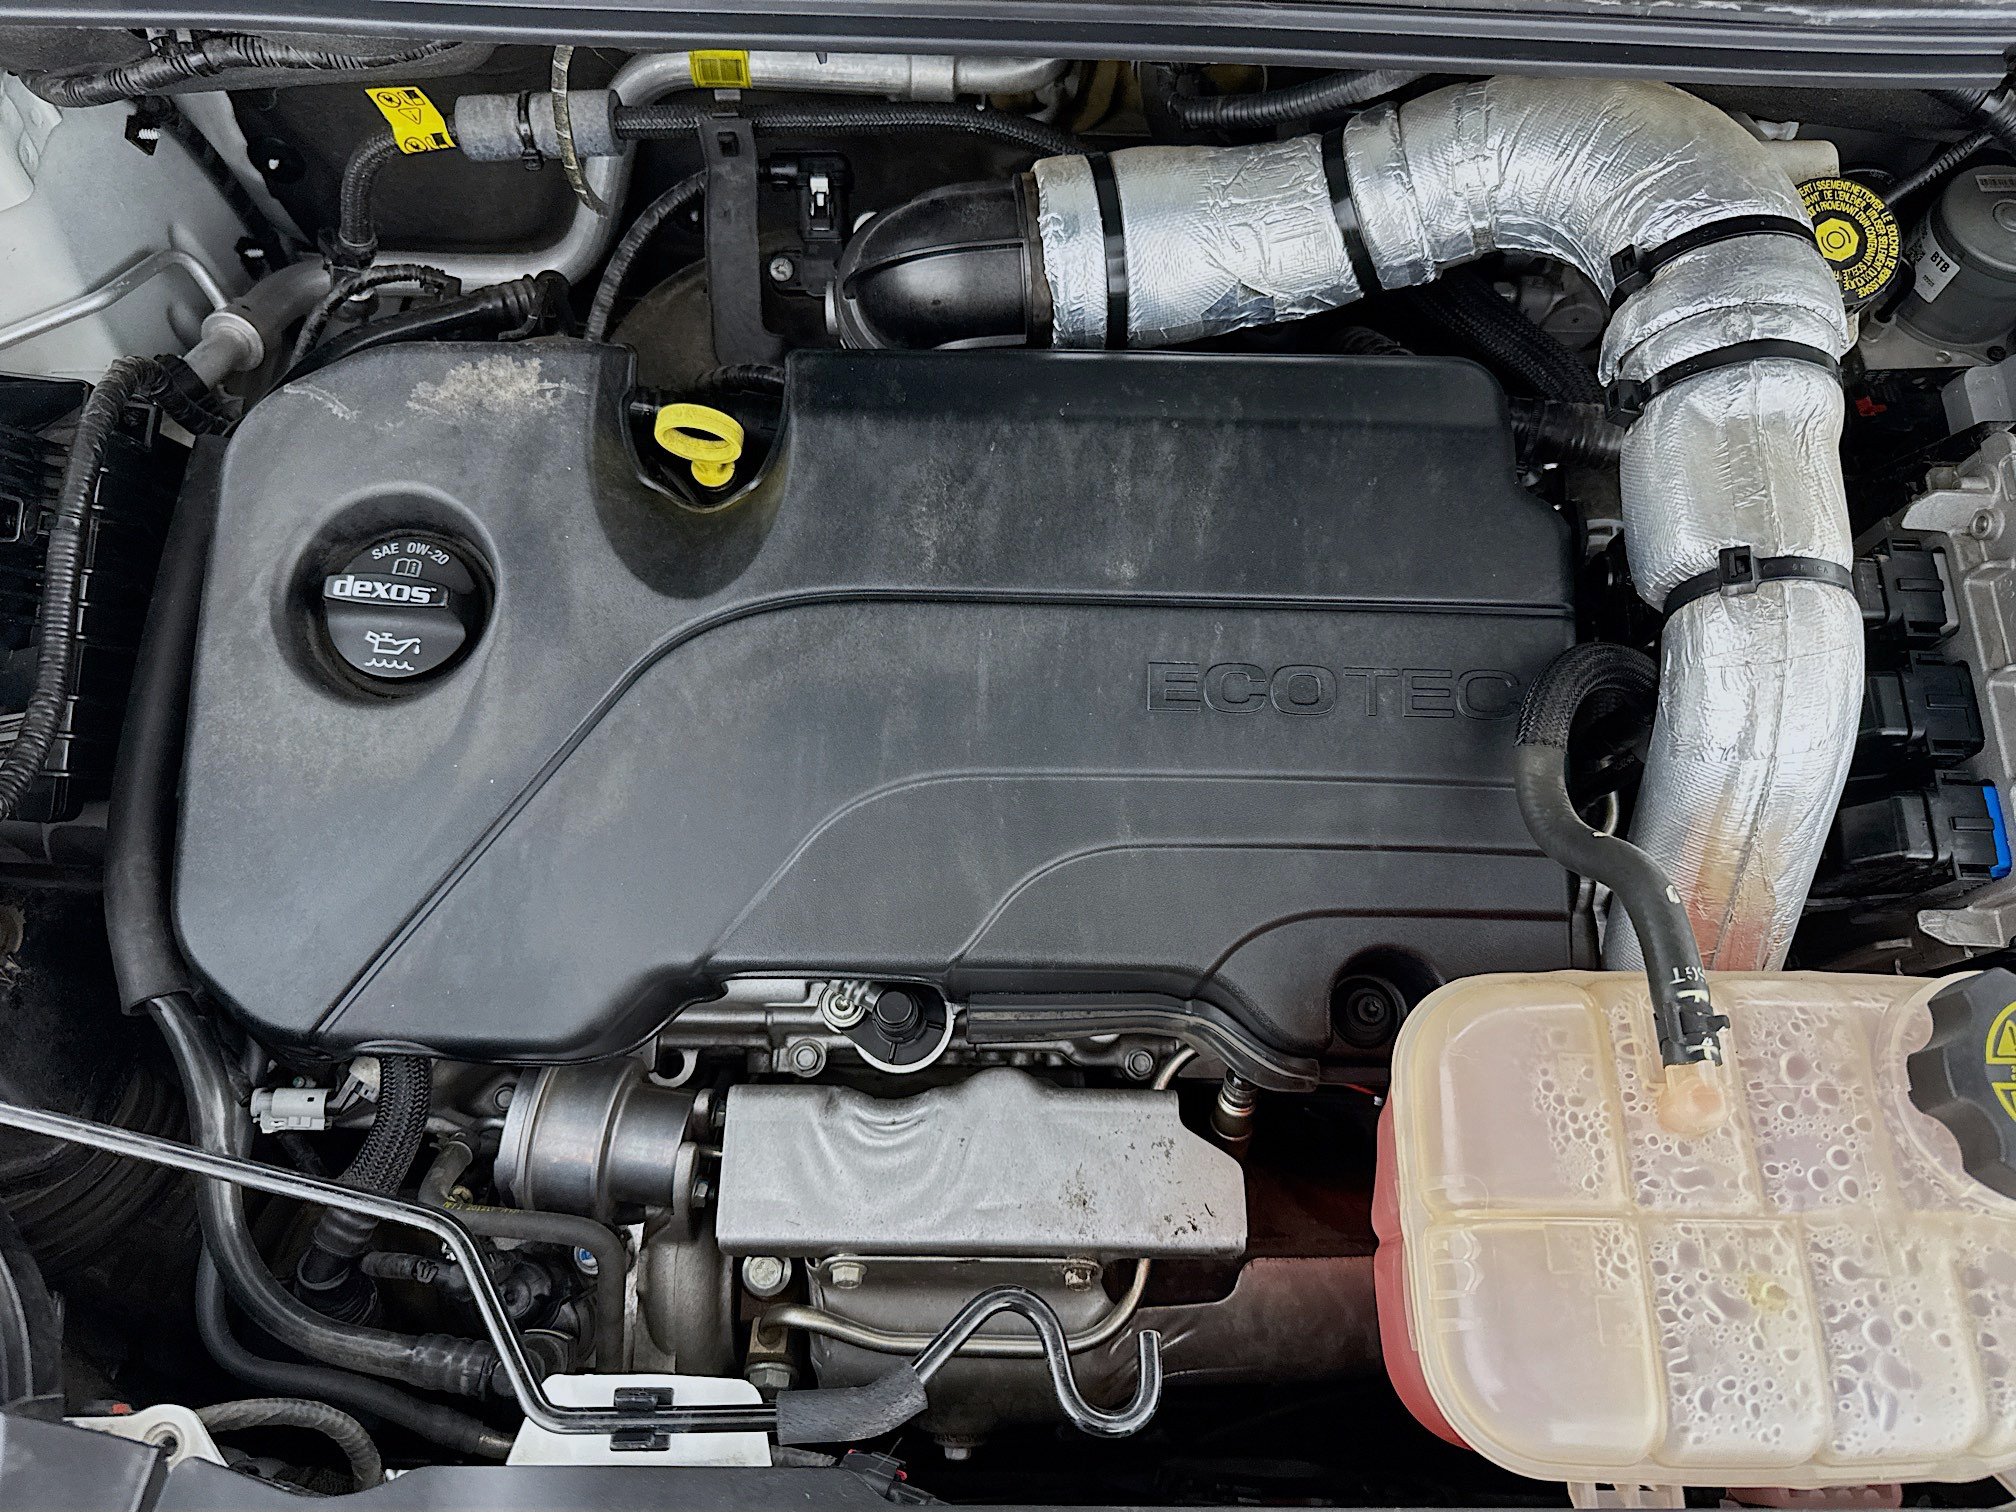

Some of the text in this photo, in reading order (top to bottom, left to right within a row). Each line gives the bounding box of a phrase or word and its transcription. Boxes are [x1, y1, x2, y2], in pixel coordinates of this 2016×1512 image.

[1824, 190, 1833, 200] DE
[1816, 204, 1820, 213] 4
[1820, 200, 1860, 218] PROVENANT
[1881, 211, 1892, 222] LE
[1886, 222, 1899, 257] BOUCHON
[1885, 257, 1897, 269] DE
[1930, 251, 1950, 273] BTB
[372, 542, 450, 565] SAE 0W-20
[1146, 661, 1520, 720] ECOTEC
